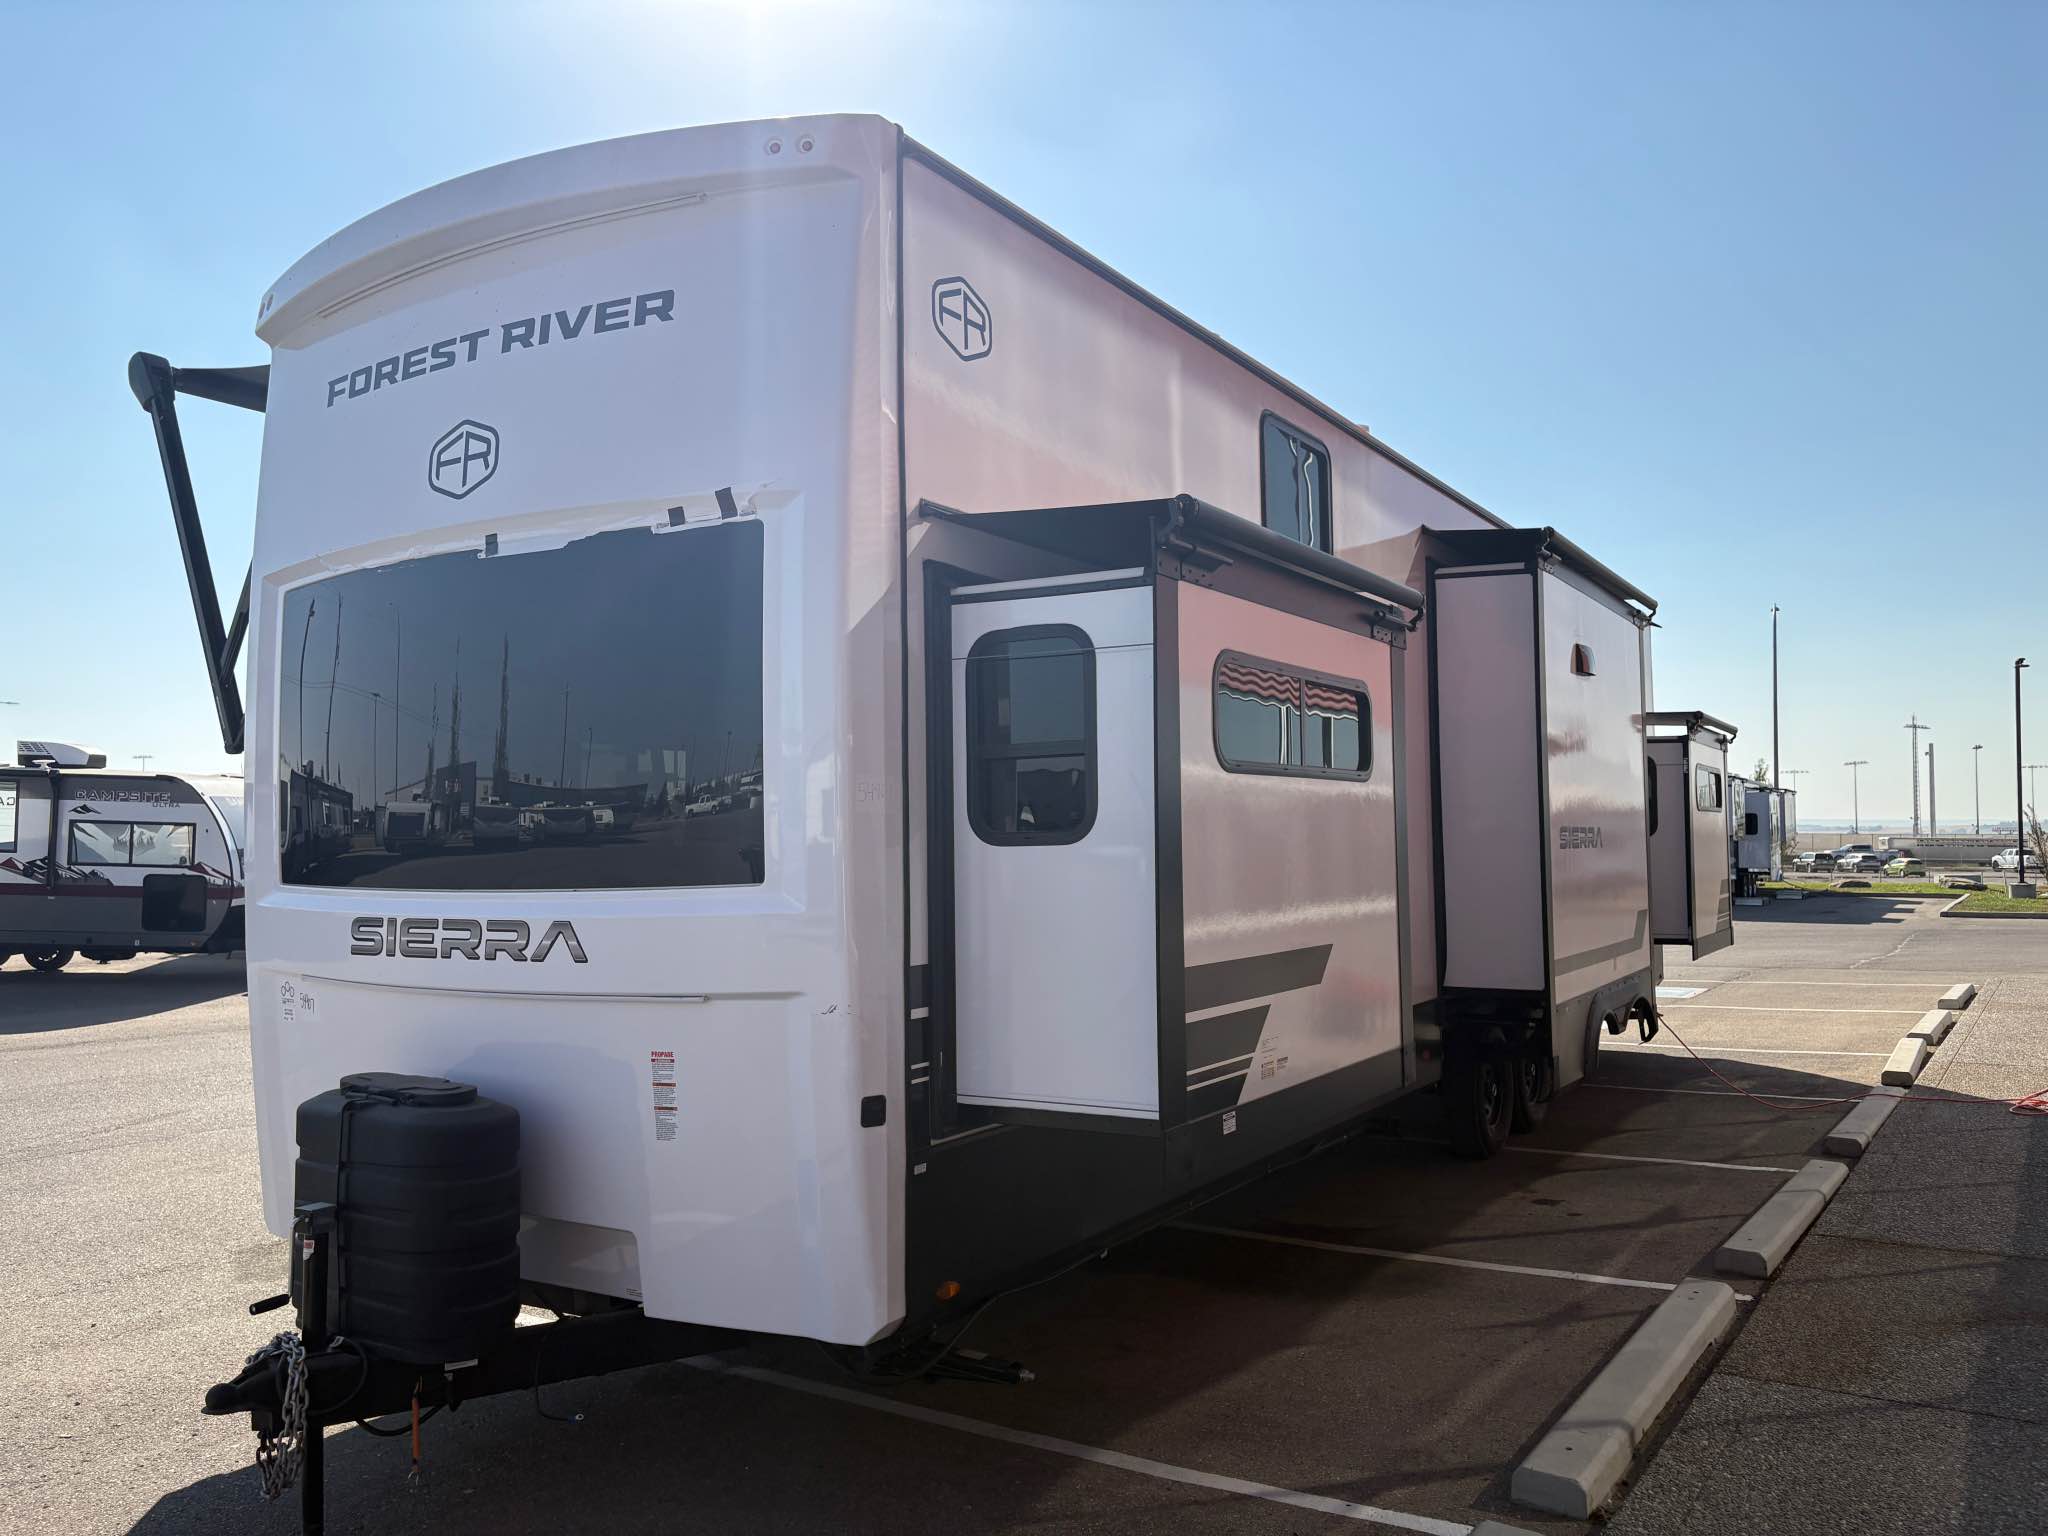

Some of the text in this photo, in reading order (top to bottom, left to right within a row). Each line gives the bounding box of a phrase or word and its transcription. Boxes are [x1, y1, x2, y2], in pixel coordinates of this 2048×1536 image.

[326, 289, 676, 409] FOREST RIVER
[75, 790, 171, 802] CAMPSITE
[1559, 826, 1603, 849] SIERRA
[350, 916, 589, 964] SIERRA
